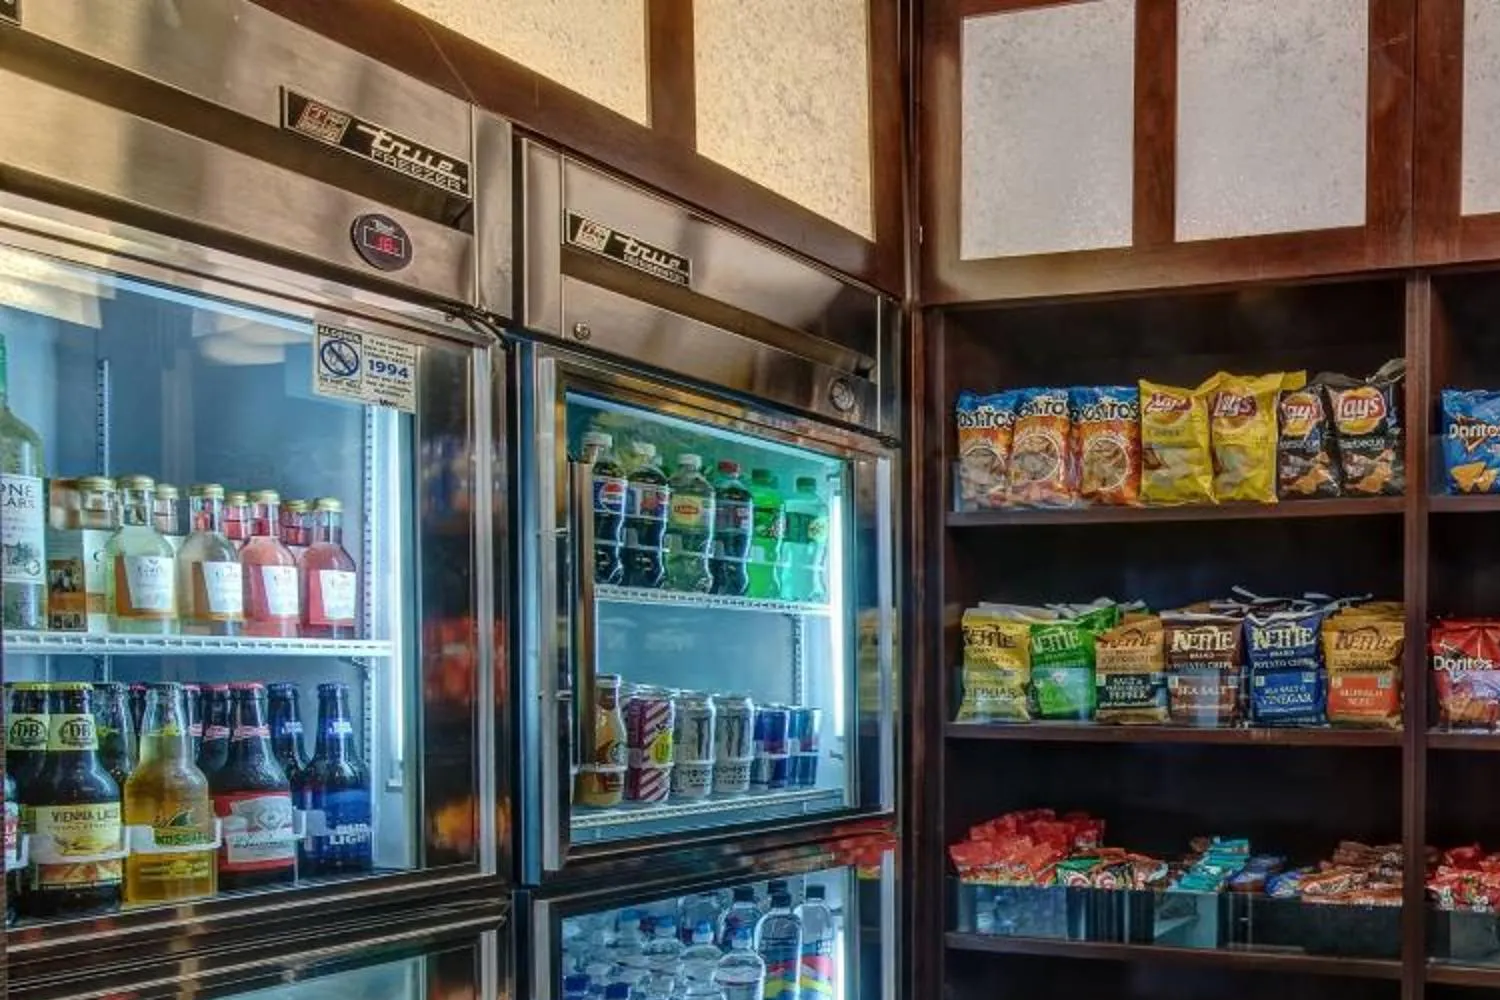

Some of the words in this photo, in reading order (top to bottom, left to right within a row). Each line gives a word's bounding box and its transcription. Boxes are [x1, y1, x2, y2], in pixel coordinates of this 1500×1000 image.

[368, 359, 408, 379] 1994
[1338, 394, 1380, 420] Lay's
[1433, 655, 1494, 671] Doritos
